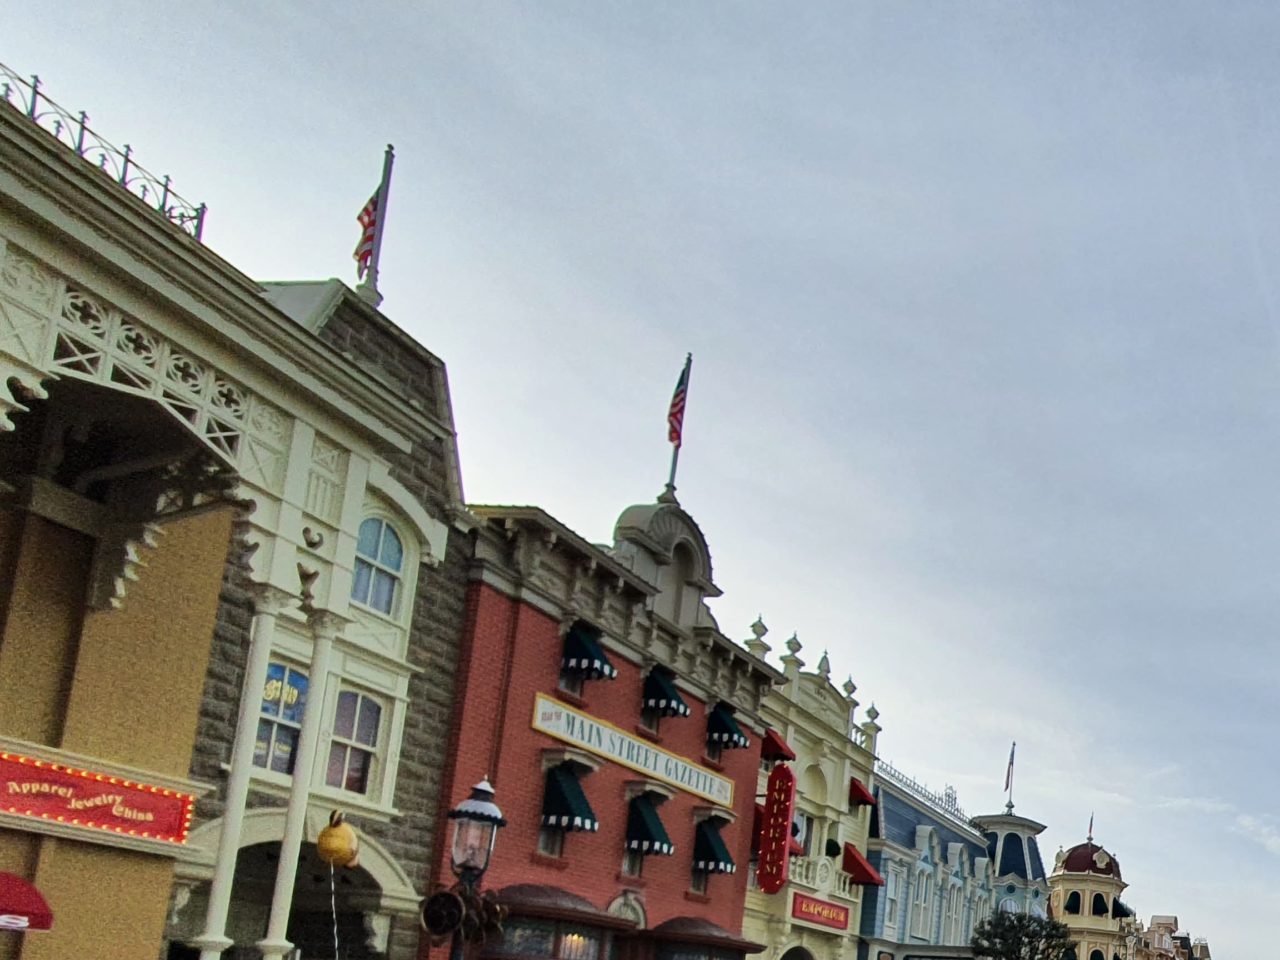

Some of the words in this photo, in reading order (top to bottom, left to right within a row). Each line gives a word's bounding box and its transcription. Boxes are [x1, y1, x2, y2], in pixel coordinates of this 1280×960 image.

[564, 712, 603, 749] MAIN
[608, 732, 660, 772] STREET
[664, 757, 715, 795] GAZETTE
[7, 781, 74, 798] Apparel
[67, 794, 124, 809] Jewelry
[112, 804, 154, 821] China
[764, 779, 788, 875] EMPORIUM
